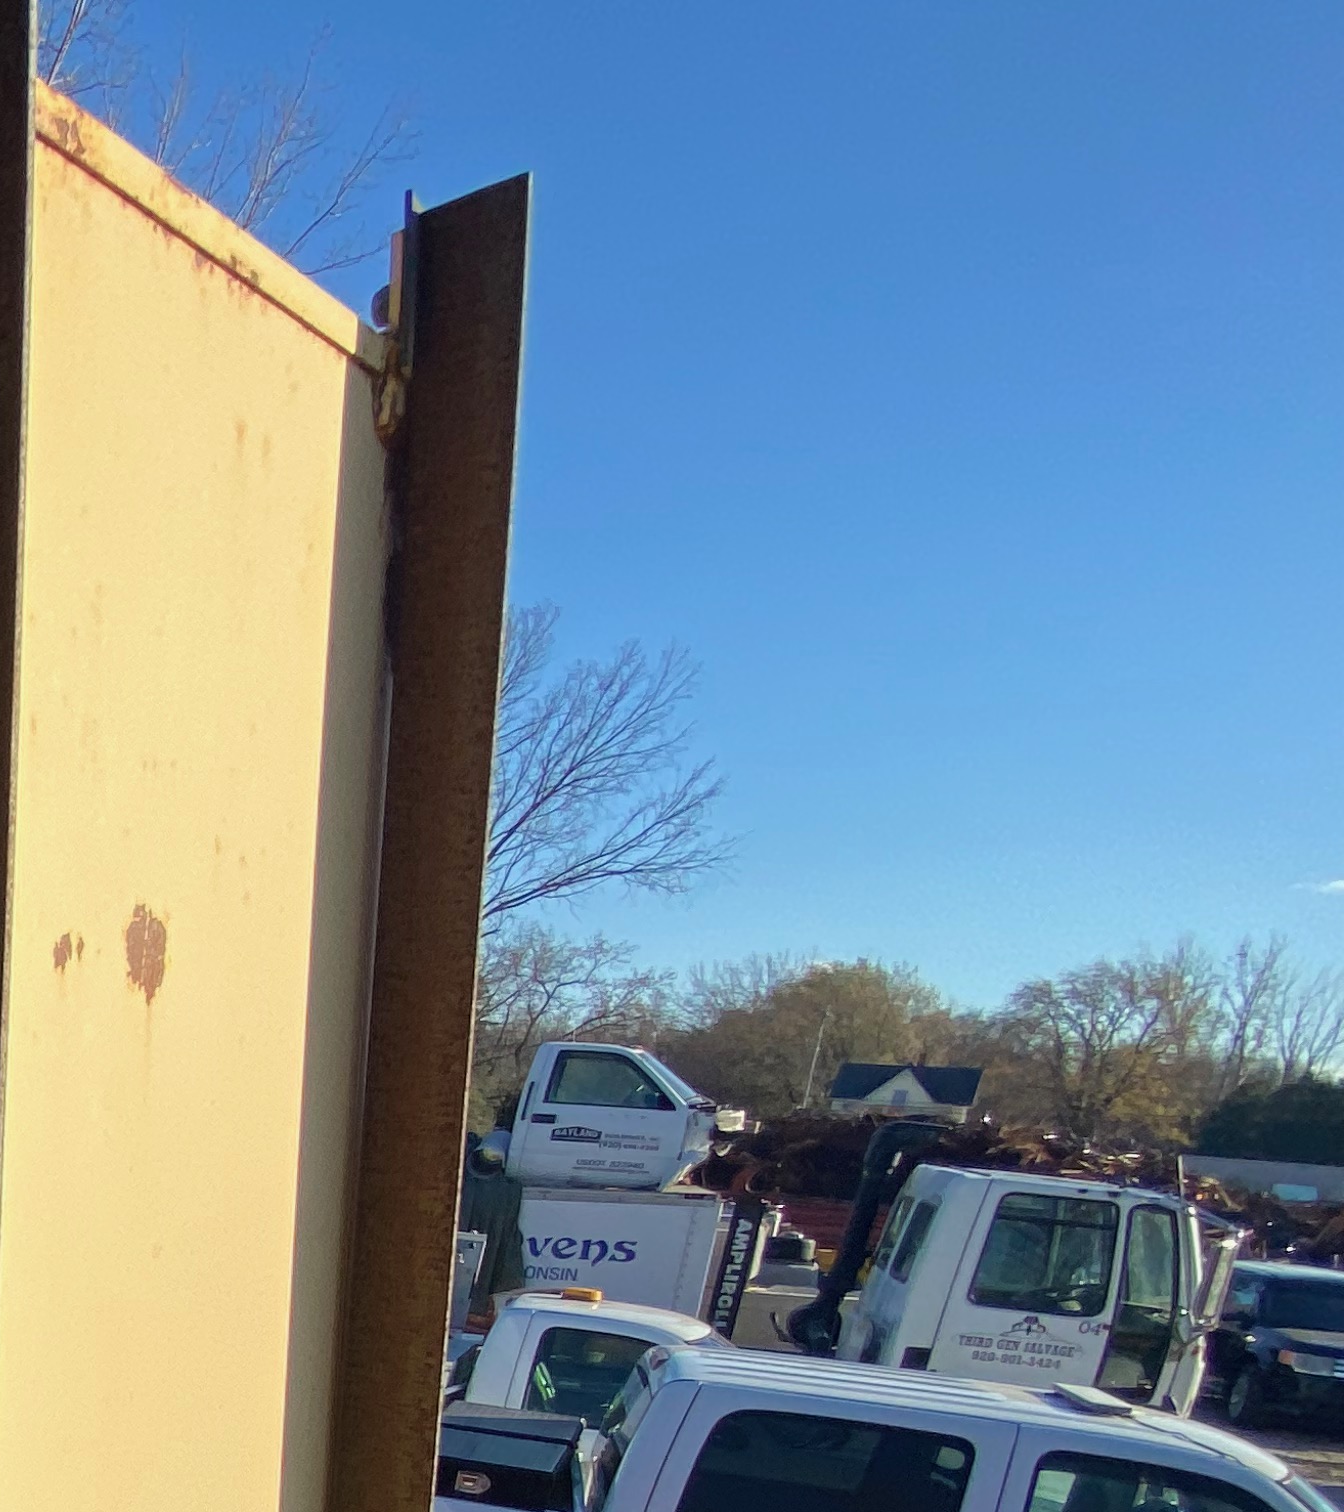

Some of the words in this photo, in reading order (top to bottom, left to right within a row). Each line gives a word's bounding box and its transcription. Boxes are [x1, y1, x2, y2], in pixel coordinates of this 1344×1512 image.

[959, 1334, 994, 1348] THIRD
[997, 1339, 1021, 1351] GEN
[1023, 1342, 1076, 1358] SALVAGE
